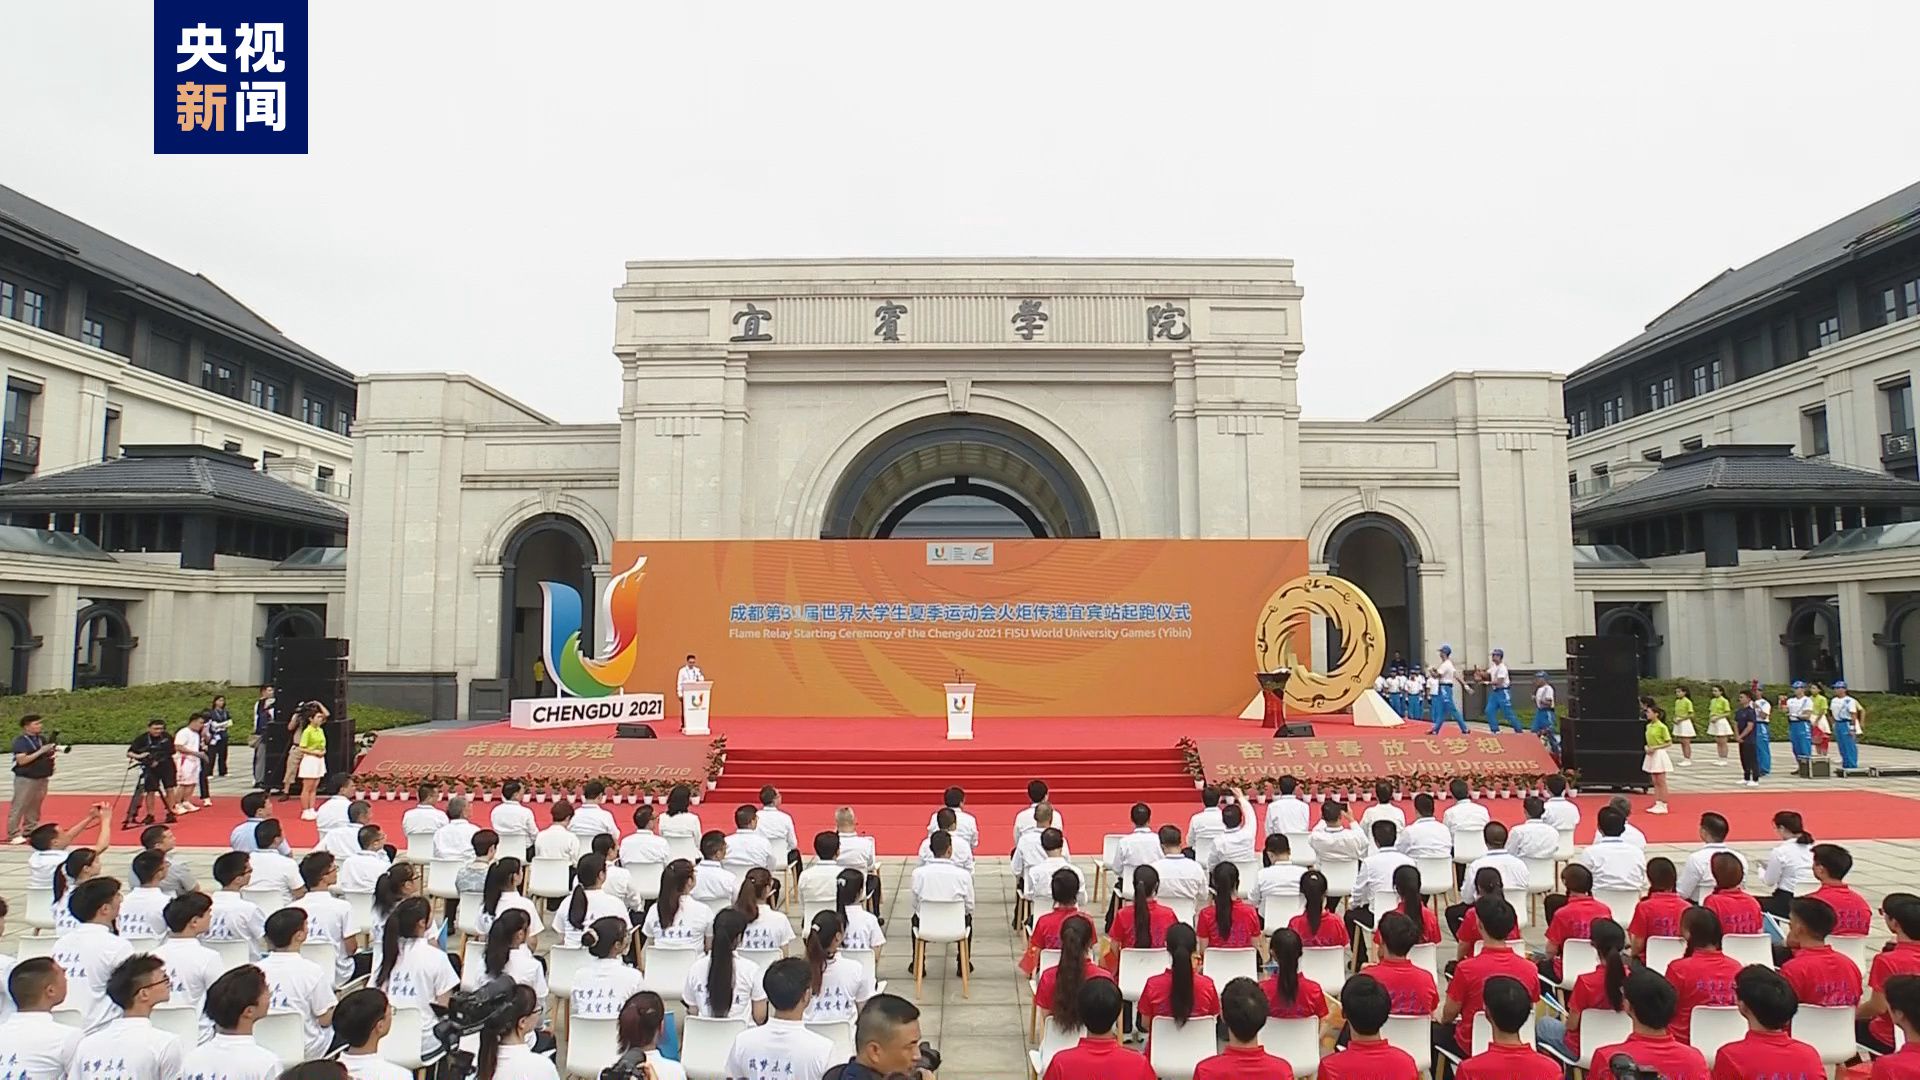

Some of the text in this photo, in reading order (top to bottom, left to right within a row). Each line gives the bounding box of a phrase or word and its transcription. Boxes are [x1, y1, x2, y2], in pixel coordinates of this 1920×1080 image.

[729, 603, 1191, 622] 成都第31届世界大学生夏季运动会火炬传递宜宾站起跑仪式
[729, 627, 1193, 641] Flame Relay Starting Ceremony of the Chengdu 2021 FISU World University Games (Yibin)
[532, 699, 663, 724] CHENGDU 2021
[463, 740, 615, 761] 成都成就梦想
[1236, 737, 1506, 759] 奋斗青春 放飞梦想
[374, 759, 693, 777] Chengdu Makes Dreams Come True
[1215, 757, 1540, 779] Striving Youth Flying Dreams
